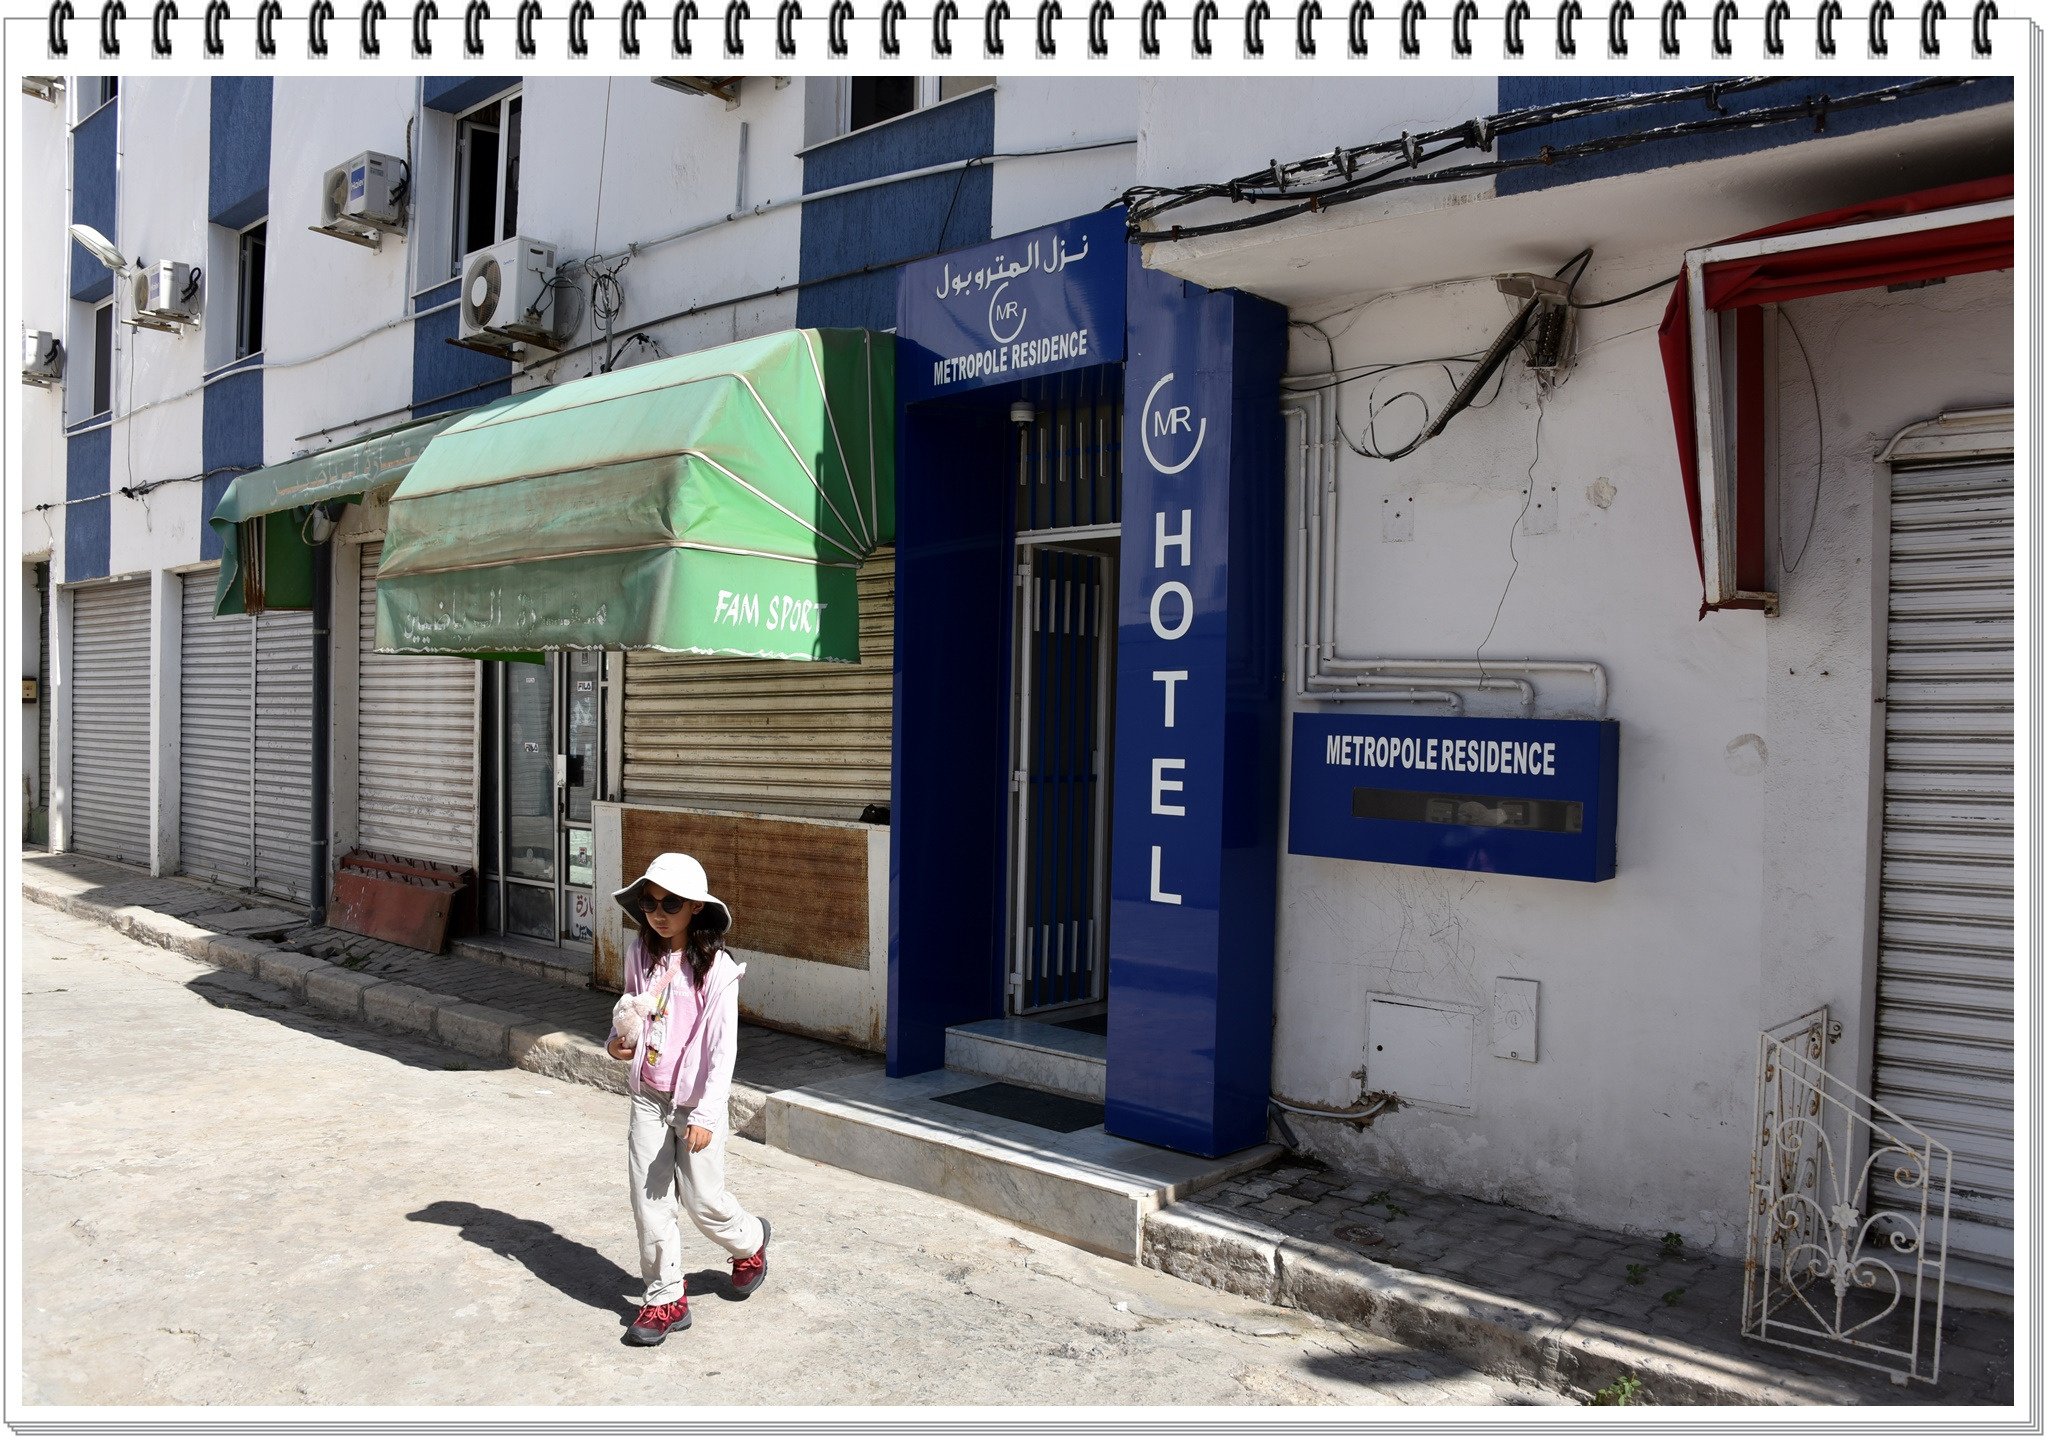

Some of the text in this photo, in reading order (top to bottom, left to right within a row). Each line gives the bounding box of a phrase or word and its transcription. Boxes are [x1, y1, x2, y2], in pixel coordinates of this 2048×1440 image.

[936, 234, 1089, 299] نزل المتروبول
[933, 329, 1088, 386] METROPOLE RESIDENCE
[713, 589, 828, 636] FAM SPORT
[577, 682, 592, 691] FILA
[1150, 509, 1194, 905] HOTEL
[1326, 735, 1556, 776] METROPOLE RESIDENCE
